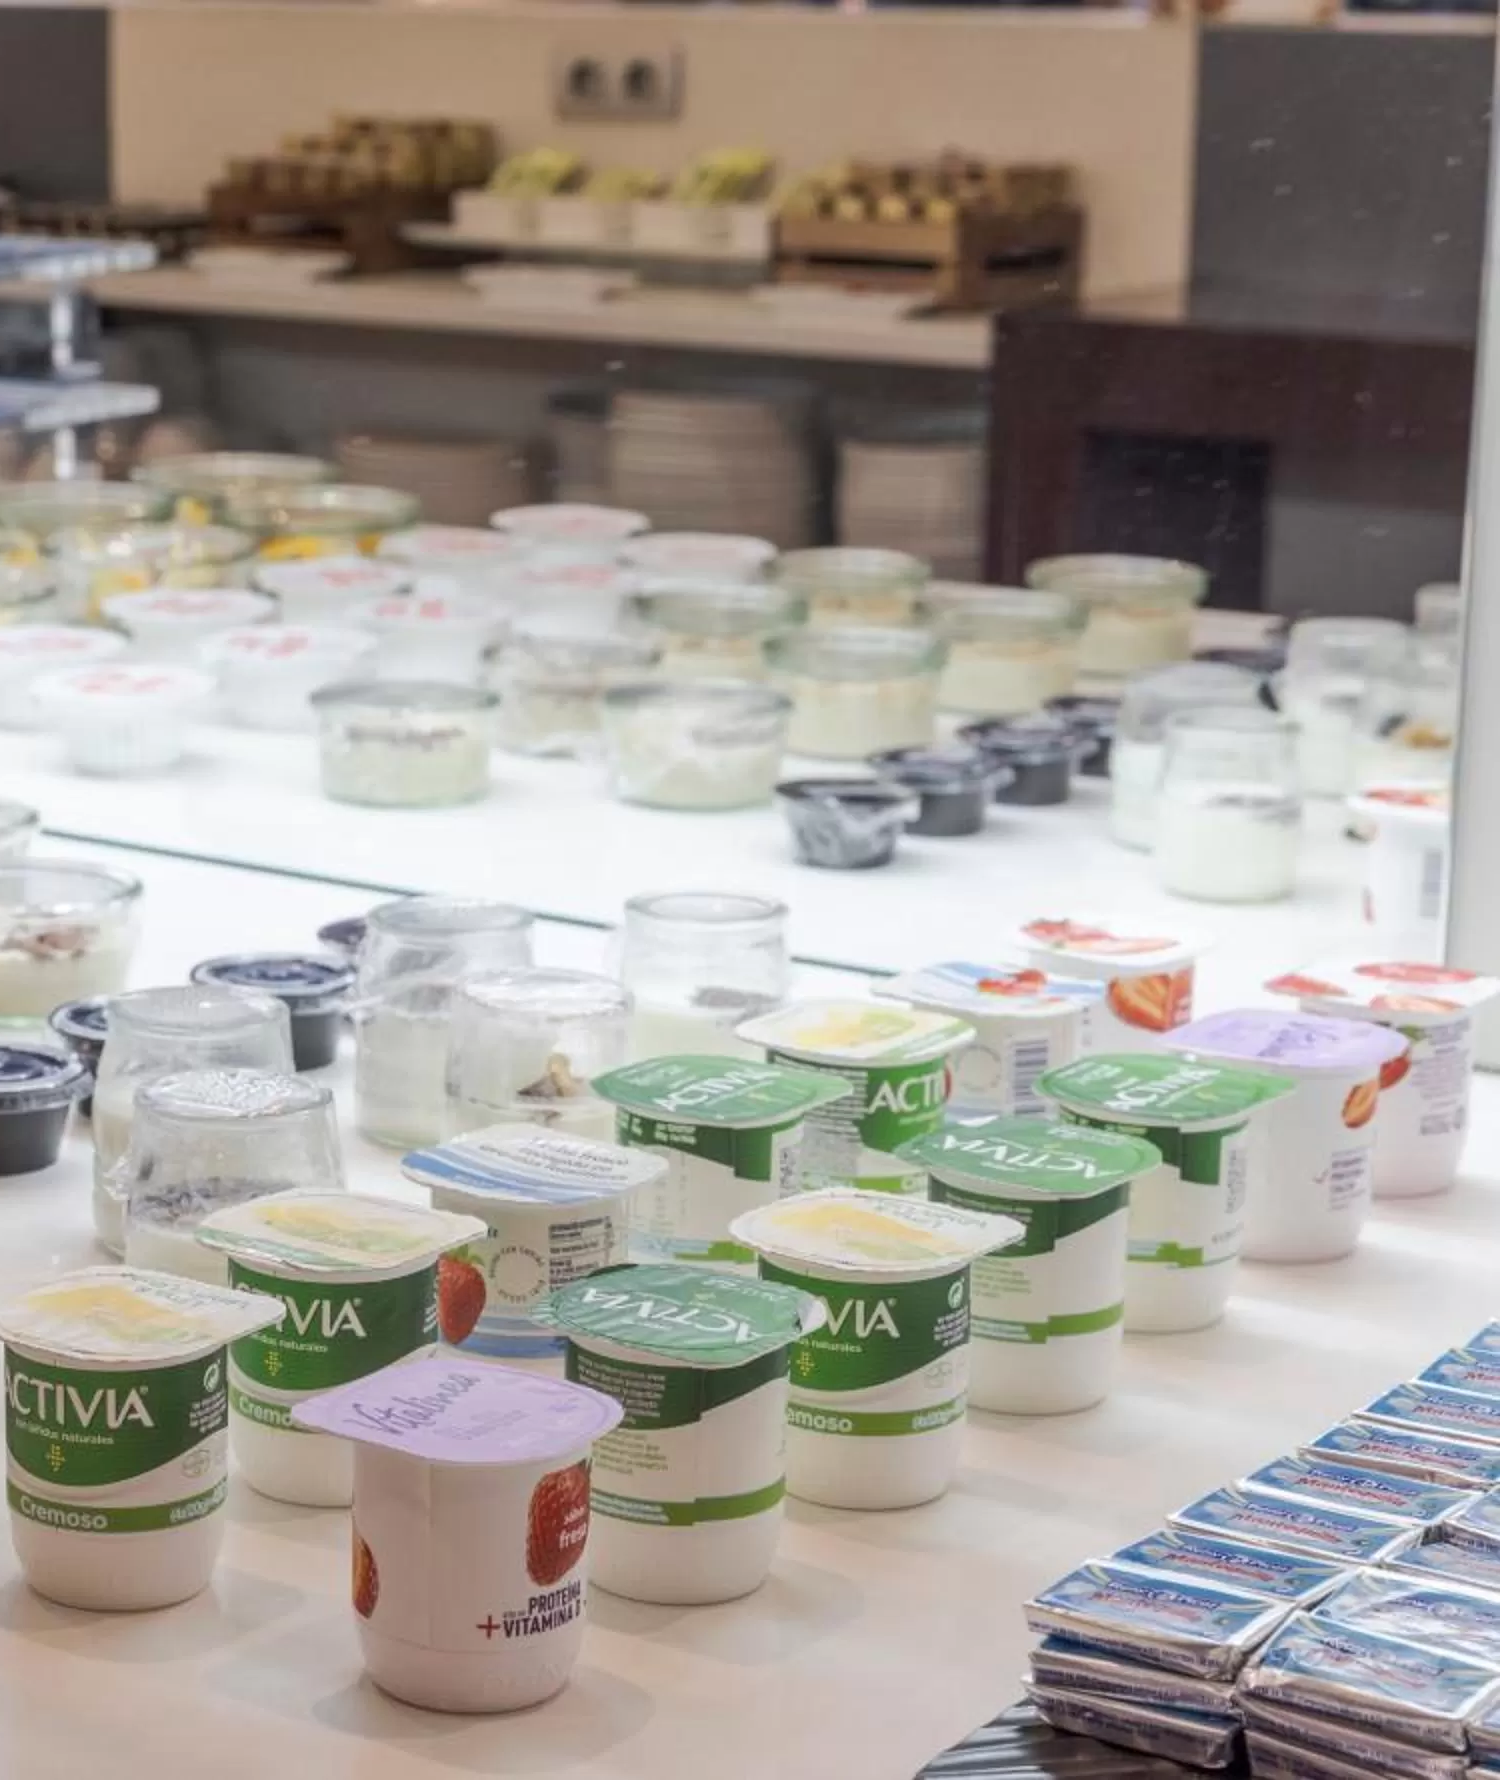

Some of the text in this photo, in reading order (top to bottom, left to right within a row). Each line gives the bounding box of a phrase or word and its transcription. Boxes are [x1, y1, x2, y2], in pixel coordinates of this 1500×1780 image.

[867, 1072, 942, 1114] ACTI
[239, 1395, 293, 1426] Cremo
[787, 1407, 853, 1433] emoso
[20, 1495, 108, 1530] Cremoso
[503, 1603, 573, 1638] VITAMINA
